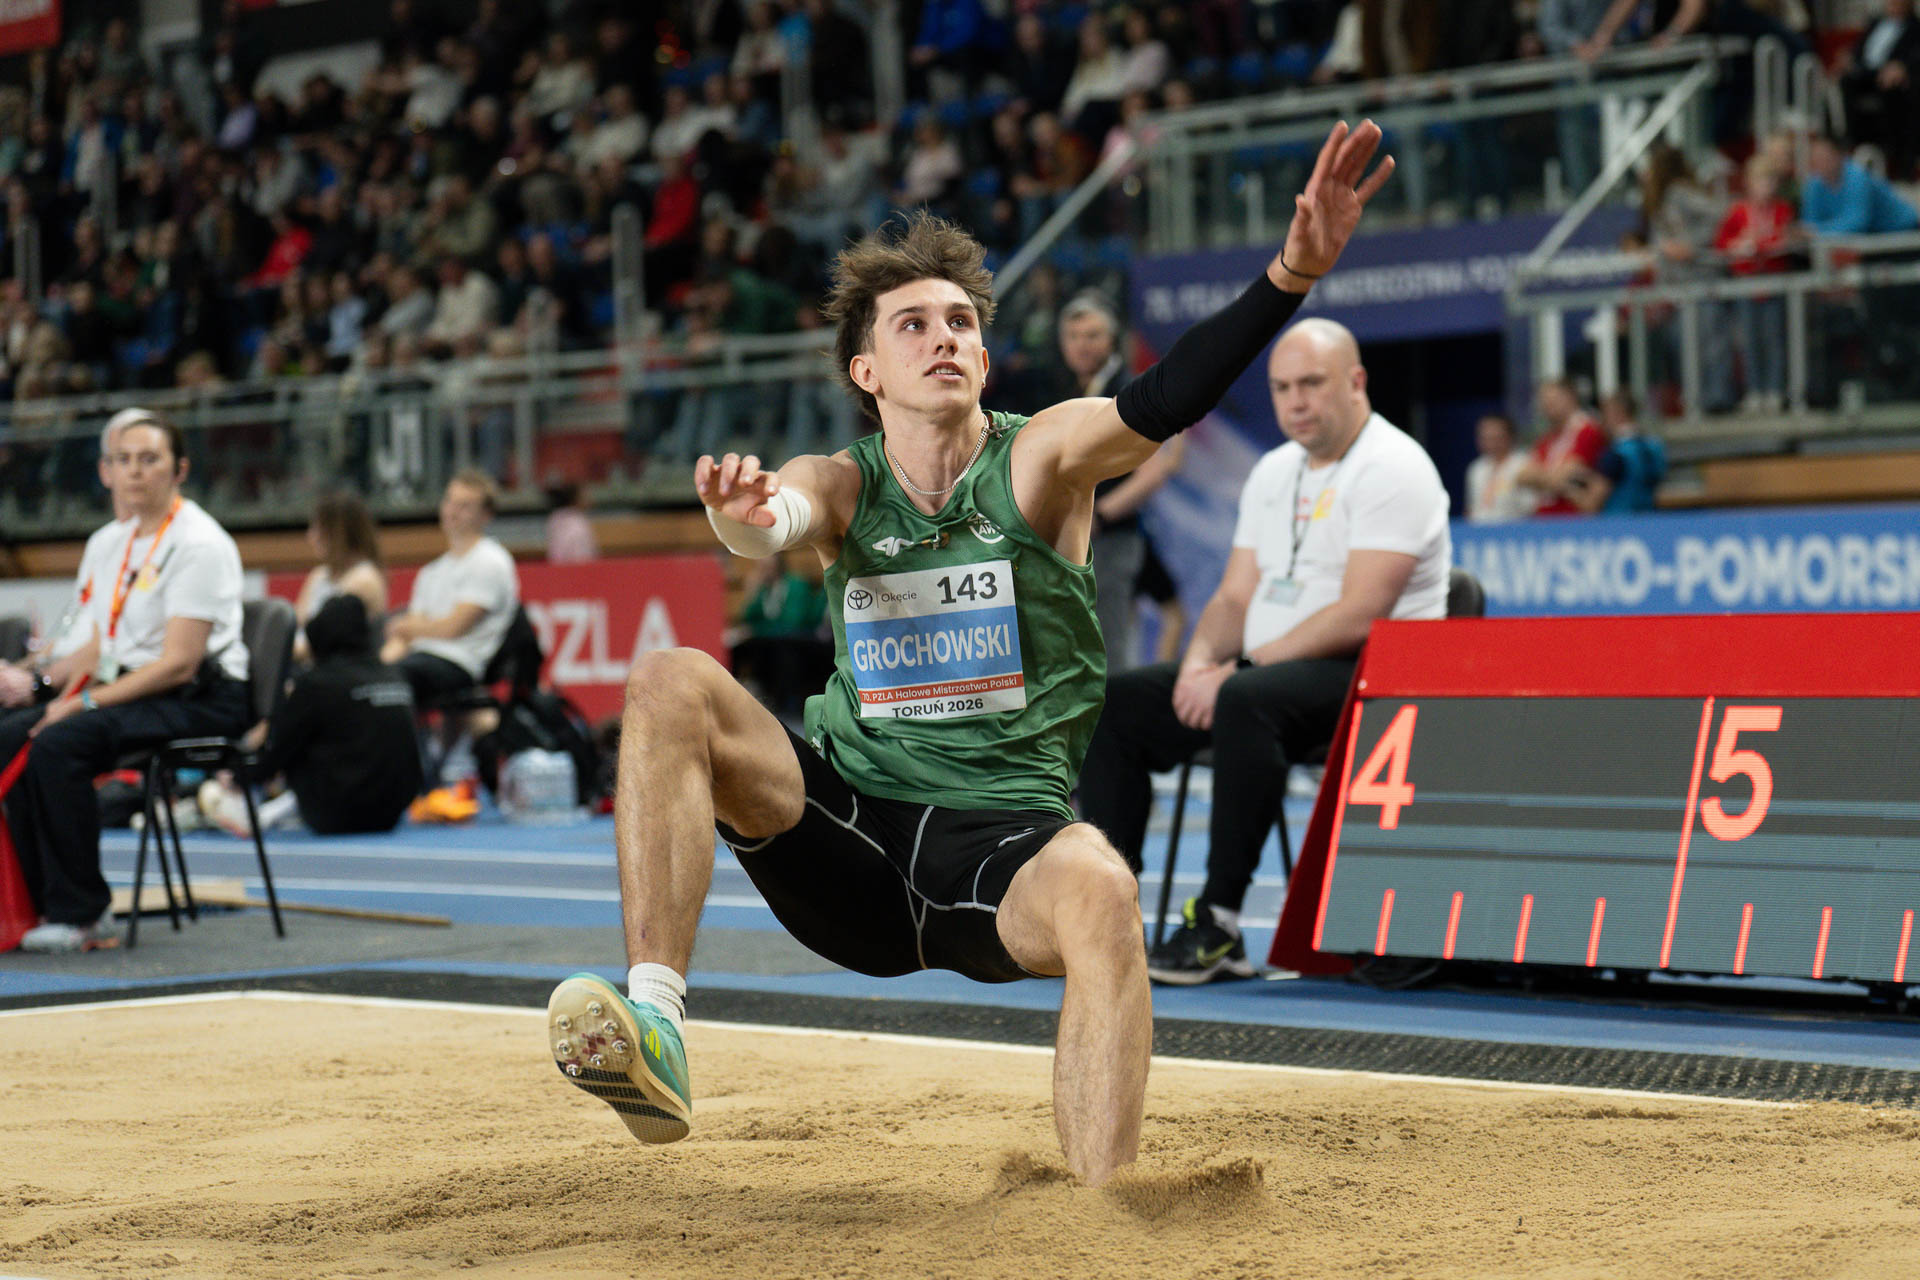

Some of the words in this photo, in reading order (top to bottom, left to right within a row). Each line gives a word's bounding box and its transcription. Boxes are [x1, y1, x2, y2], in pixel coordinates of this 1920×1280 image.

[881, 591, 917, 604] Okęcie
[936, 571, 998, 605] 143
[853, 624, 1011, 672] GROCHOWSKI
[872, 691, 894, 702] PZLA
[895, 688, 931, 699] Halowe
[933, 682, 988, 695] Mistrzostwa
[990, 677, 1017, 688] Polski
[892, 699, 944, 718] TORUŃ
[947, 698, 984, 712] 2026
[1347, 704, 1419, 830] 4
[1700, 705, 1783, 841] 5
